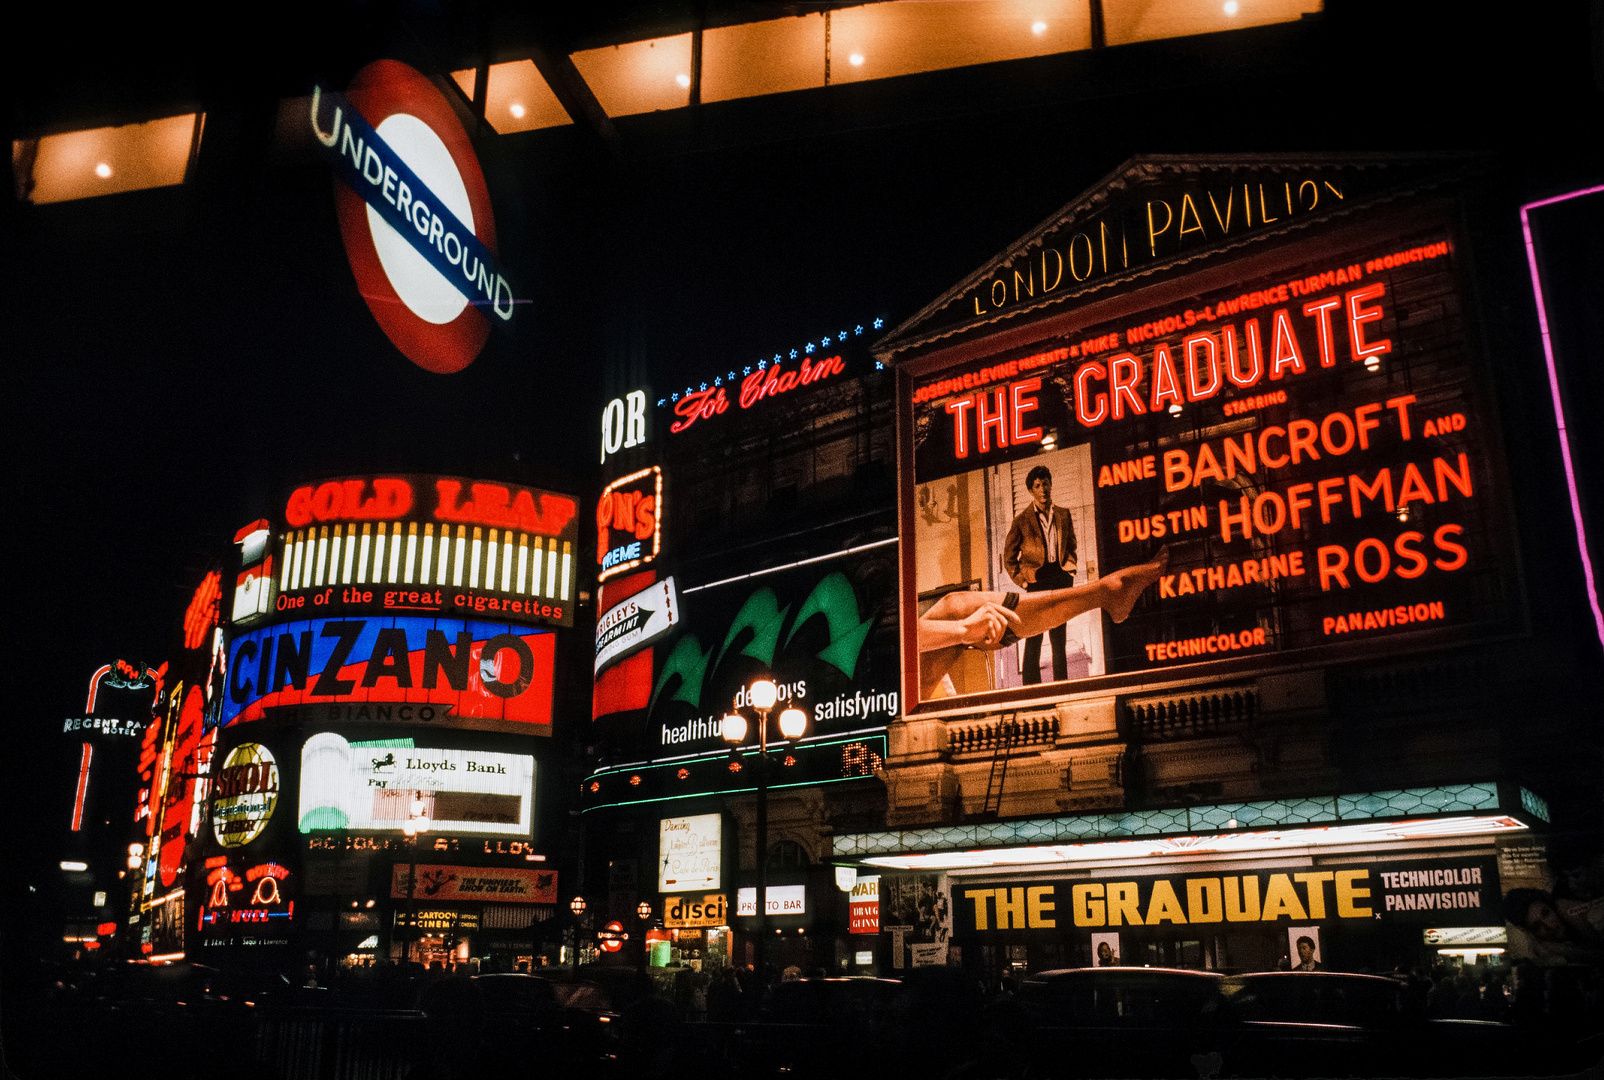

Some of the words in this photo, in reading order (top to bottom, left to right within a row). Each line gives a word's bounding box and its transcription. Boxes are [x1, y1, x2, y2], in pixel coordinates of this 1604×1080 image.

[311, 84, 514, 321] UNDERGROUND
[975, 215, 1128, 316] LONDON
[912, 375, 964, 405] JOSEPH
[972, 360, 1019, 386] LEVINE
[1018, 347, 1069, 372] PRESENTS
[1068, 345, 1080, 358] A
[1081, 332, 1120, 356] MIKE
[1287, 263, 1362, 298] TURMAN
[1365, 240, 1449, 274] PRODUCTION
[945, 376, 1043, 459] THE
[1073, 281, 1392, 428] GRADUATE
[671, 386, 730, 434] For
[738, 355, 846, 409] Charm
[1223, 389, 1288, 417] STARRING
[1098, 454, 1157, 489] ANNE
[1162, 393, 1417, 493] BANCROFT
[1422, 412, 1466, 439] AND
[285, 478, 414, 527] GOLD
[433, 479, 576, 537] LEAF
[1118, 503, 1208, 544] DUSTIN
[1218, 452, 1474, 544] HOFFMAN
[1159, 550, 1306, 600] KATHARINE
[1316, 522, 1469, 592] ROSS
[276, 592, 305, 612] One
[313, 589, 331, 605] of
[342, 586, 373, 604] the
[383, 587, 443, 607] great
[454, 592, 563, 620] cigarettes
[1322, 600, 1445, 636] PANAVISION
[1145, 626, 1266, 662] TECHNICOLOR
[230, 619, 535, 704] CINZANO
[327, 705, 436, 722] BIANCO
[814, 691, 898, 722] satisfying
[63, 718, 120, 733] REGENT
[102, 727, 137, 737] HOTEL
[216, 761, 277, 799] SKOL
[406, 758, 457, 773] Lloyds
[466, 760, 507, 775] Bank
[367, 778, 388, 789] Pay
[664, 819, 691, 835] Dancing
[462, 878, 477, 886] THE
[478, 878, 521, 887] FUNNIEST
[486, 885, 498, 893] ON
[1380, 866, 1483, 890] TECHNICOLOR
[417, 911, 458, 919] CARTOON
[671, 895, 723, 920] disci
[766, 901, 779, 910] TO
[783, 900, 802, 910] BAR
[964, 885, 1056, 931] THE
[1071, 868, 1373, 928] GRADUATE
[1384, 890, 1481, 912] PANAVISION
